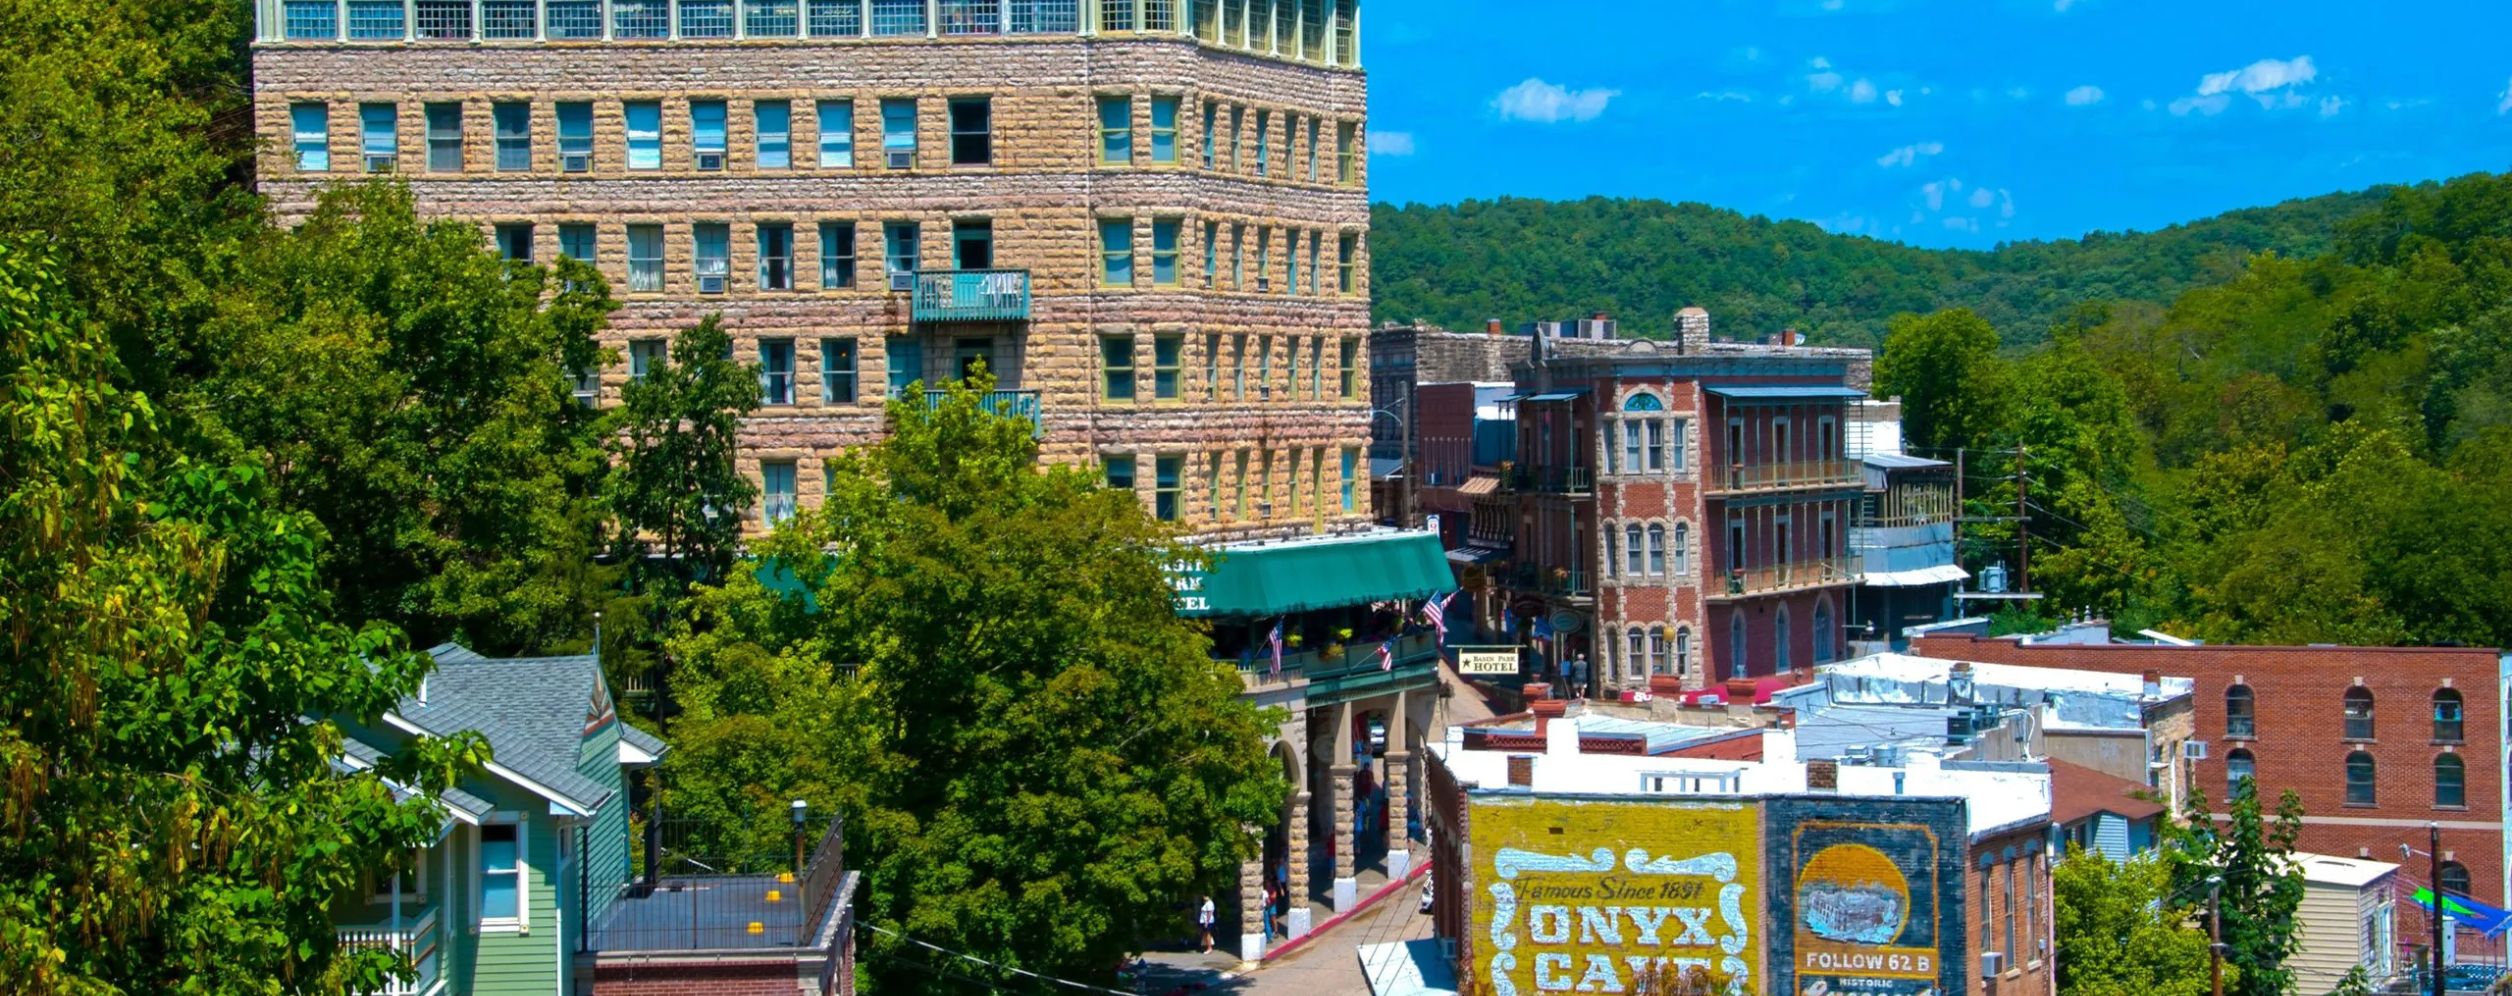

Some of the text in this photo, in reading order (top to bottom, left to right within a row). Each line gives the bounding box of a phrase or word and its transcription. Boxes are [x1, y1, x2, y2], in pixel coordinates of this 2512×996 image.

[1474, 663, 1517, 671] HOTEL
[1514, 877, 1593, 900] Famous
[1597, 876, 1655, 900] Since
[1529, 905, 1716, 946] ONYX
[1806, 952, 1931, 972] FOLLOW 62 B
[1839, 978, 1894, 988] HISTORIC
